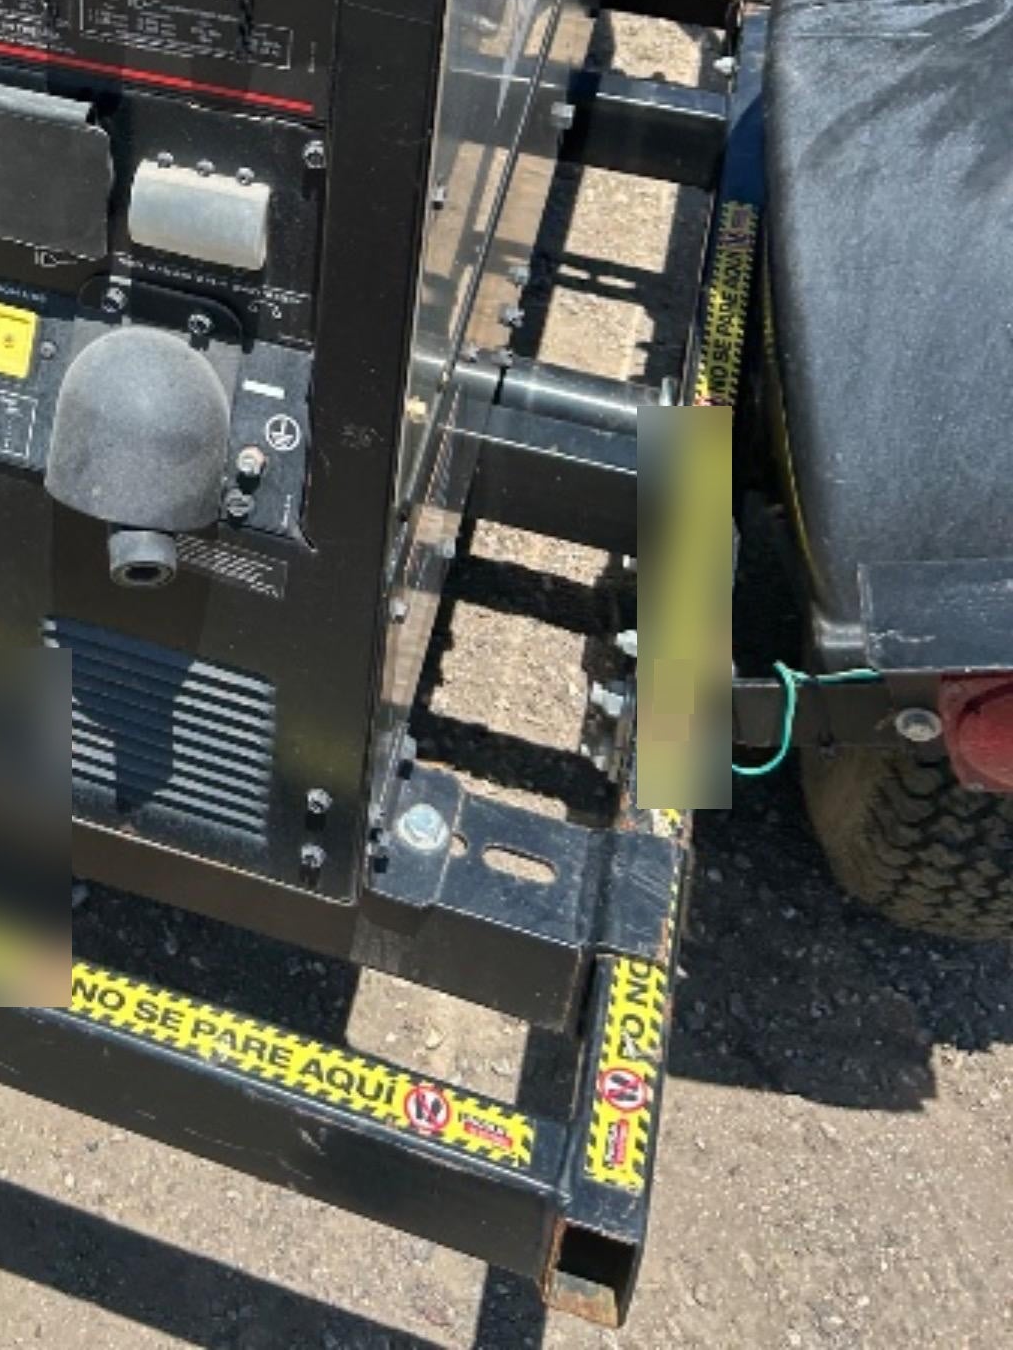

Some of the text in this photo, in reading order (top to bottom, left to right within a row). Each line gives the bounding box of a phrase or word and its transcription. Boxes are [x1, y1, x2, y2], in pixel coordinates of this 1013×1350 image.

[71, 977, 126, 1011] NO
[134, 999, 186, 1032] SE
[191, 1018, 294, 1069] PARE
